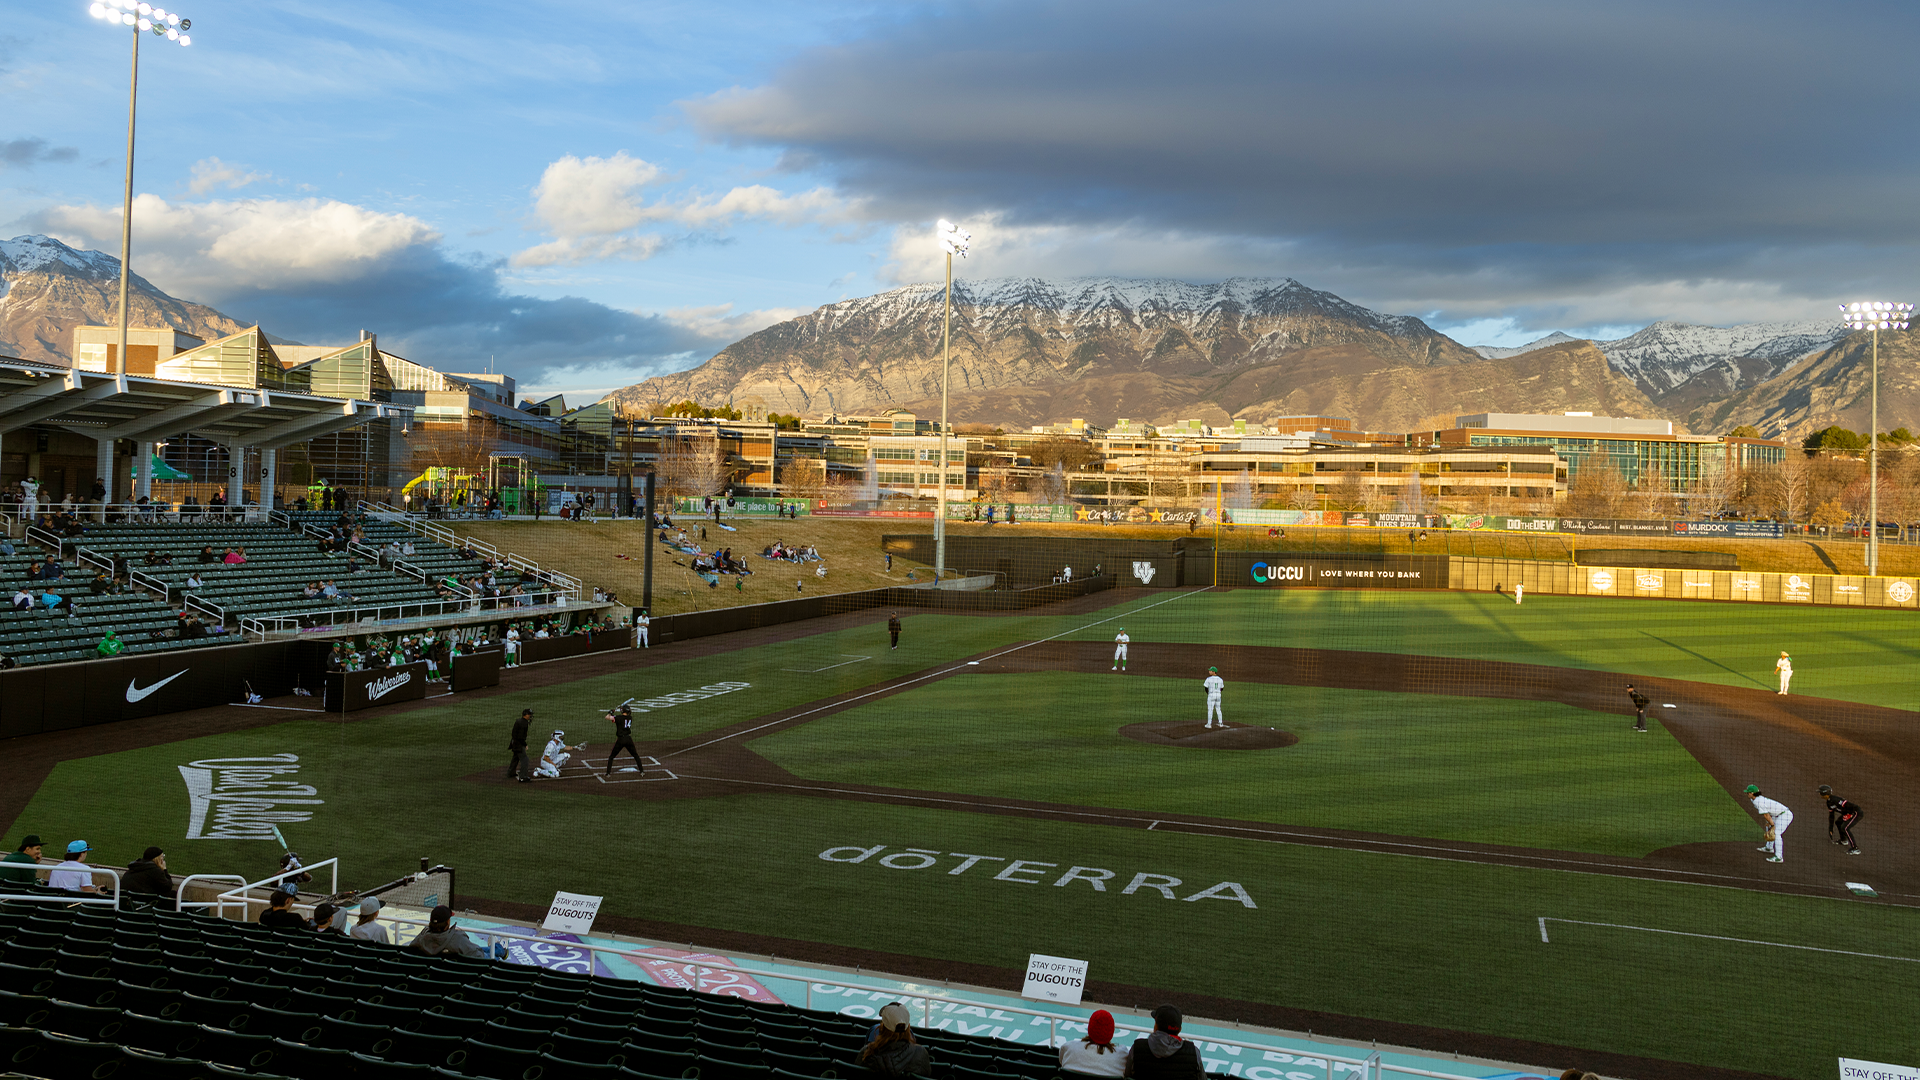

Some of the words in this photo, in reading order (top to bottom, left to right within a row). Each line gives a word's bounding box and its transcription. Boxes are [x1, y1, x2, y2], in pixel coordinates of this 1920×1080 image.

[230, 467, 237, 478] 8
[262, 468, 268, 478] 9
[748, 502, 766, 512] place
[768, 502, 775, 512] to
[796, 502, 805, 511] UP
[1161, 511, 1184, 522] Carl's
[1507, 519, 1520, 529] DO
[1533, 520, 1556, 530] DEW
[1688, 524, 1728, 532] MURDOCK
[1268, 566, 1303, 580] UCCU
[365, 671, 411, 700] Wolverines
[624, 719, 632, 729] 14
[551, 907, 594, 920] DUGOUTS
[1031, 960, 1049, 970] STAY
[1051, 963, 1066, 972] OFF
[1068, 966, 1083, 975] THE
[1028, 972, 1082, 987] DUGOUTS
[1844, 1067, 1869, 1078] STAY
[1873, 1071, 1893, 1080] OFF
